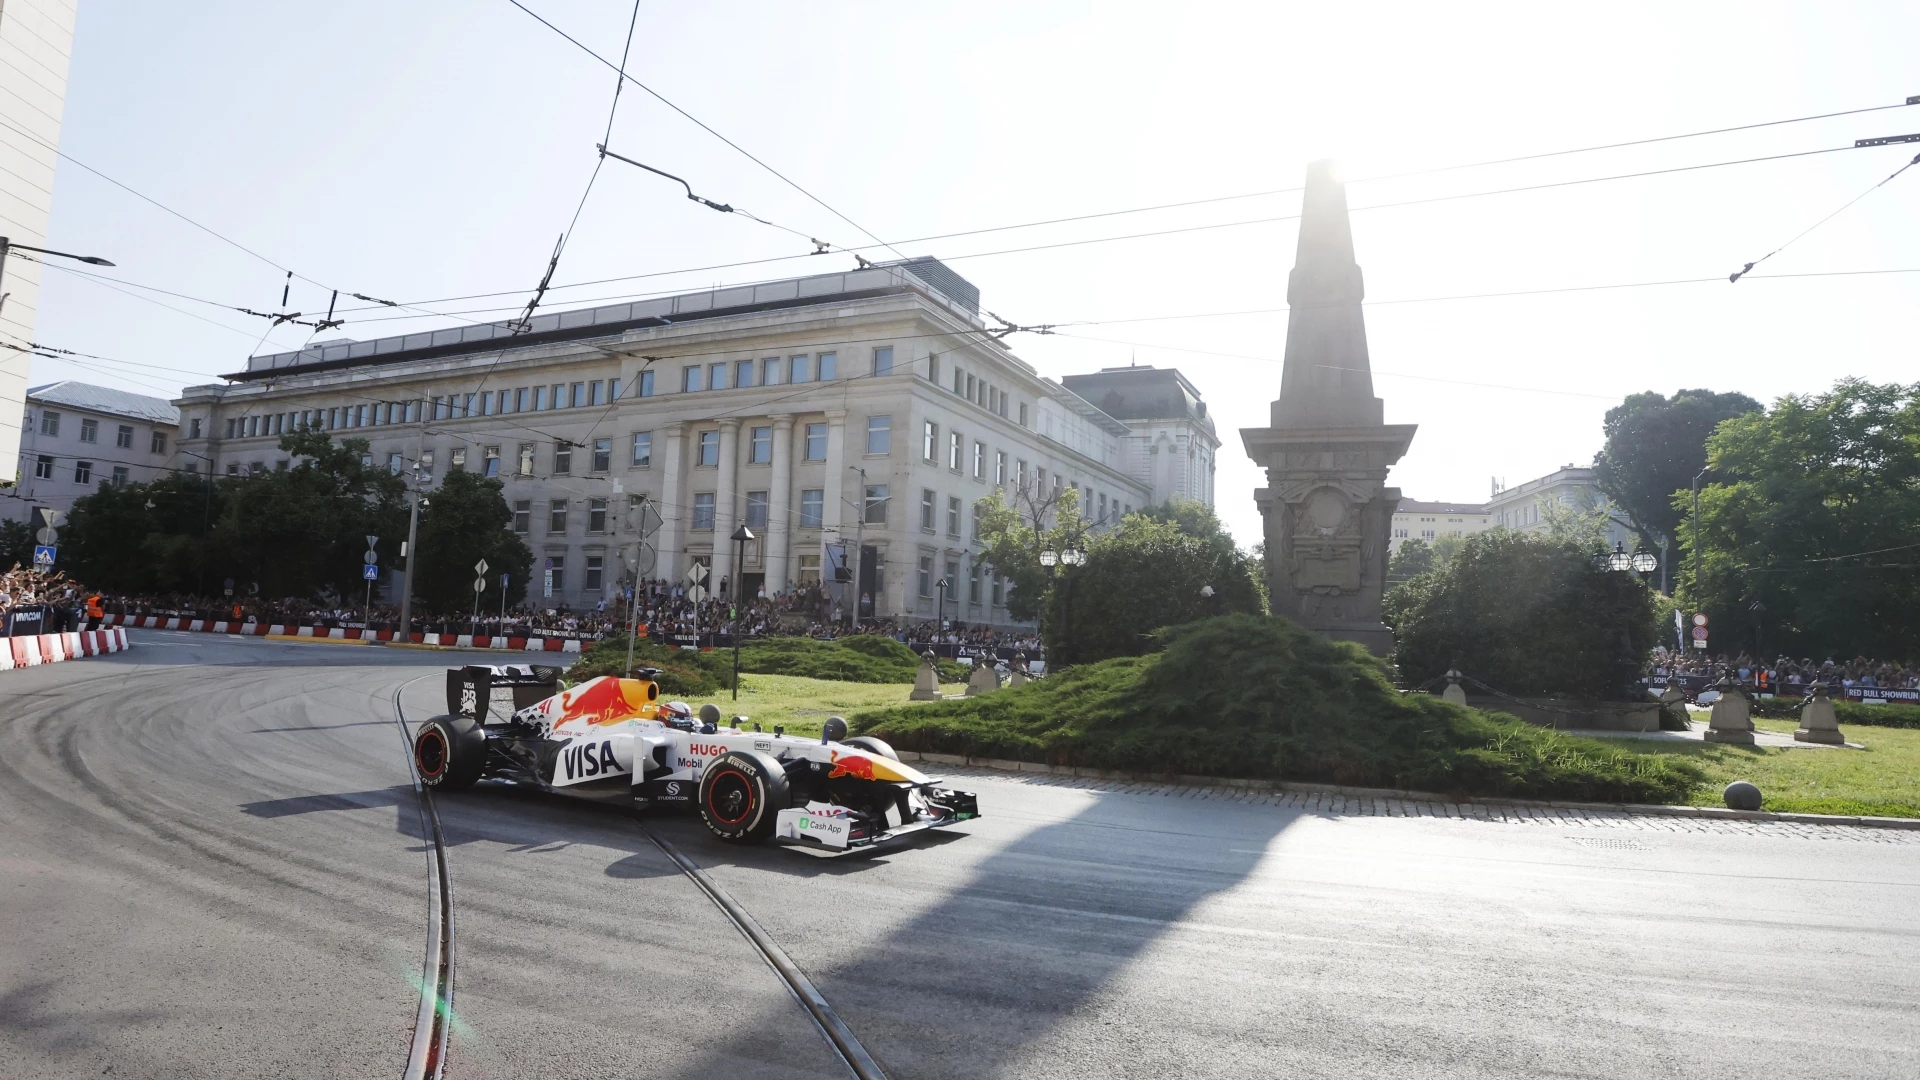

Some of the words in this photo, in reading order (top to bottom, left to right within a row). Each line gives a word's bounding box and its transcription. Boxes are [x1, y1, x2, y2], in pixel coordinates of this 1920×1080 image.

[16, 612, 41, 622] VIVACOM
[1881, 691, 1918, 699] SHOWRUN
[538, 698, 553, 714] 41
[690, 744, 728, 756] HUGO
[564, 740, 624, 780] VISA
[678, 758, 702, 768] Mobil
[727, 755, 756, 776] PIRELLI
[810, 821, 826, 830] Cash
[827, 824, 842, 833] App
